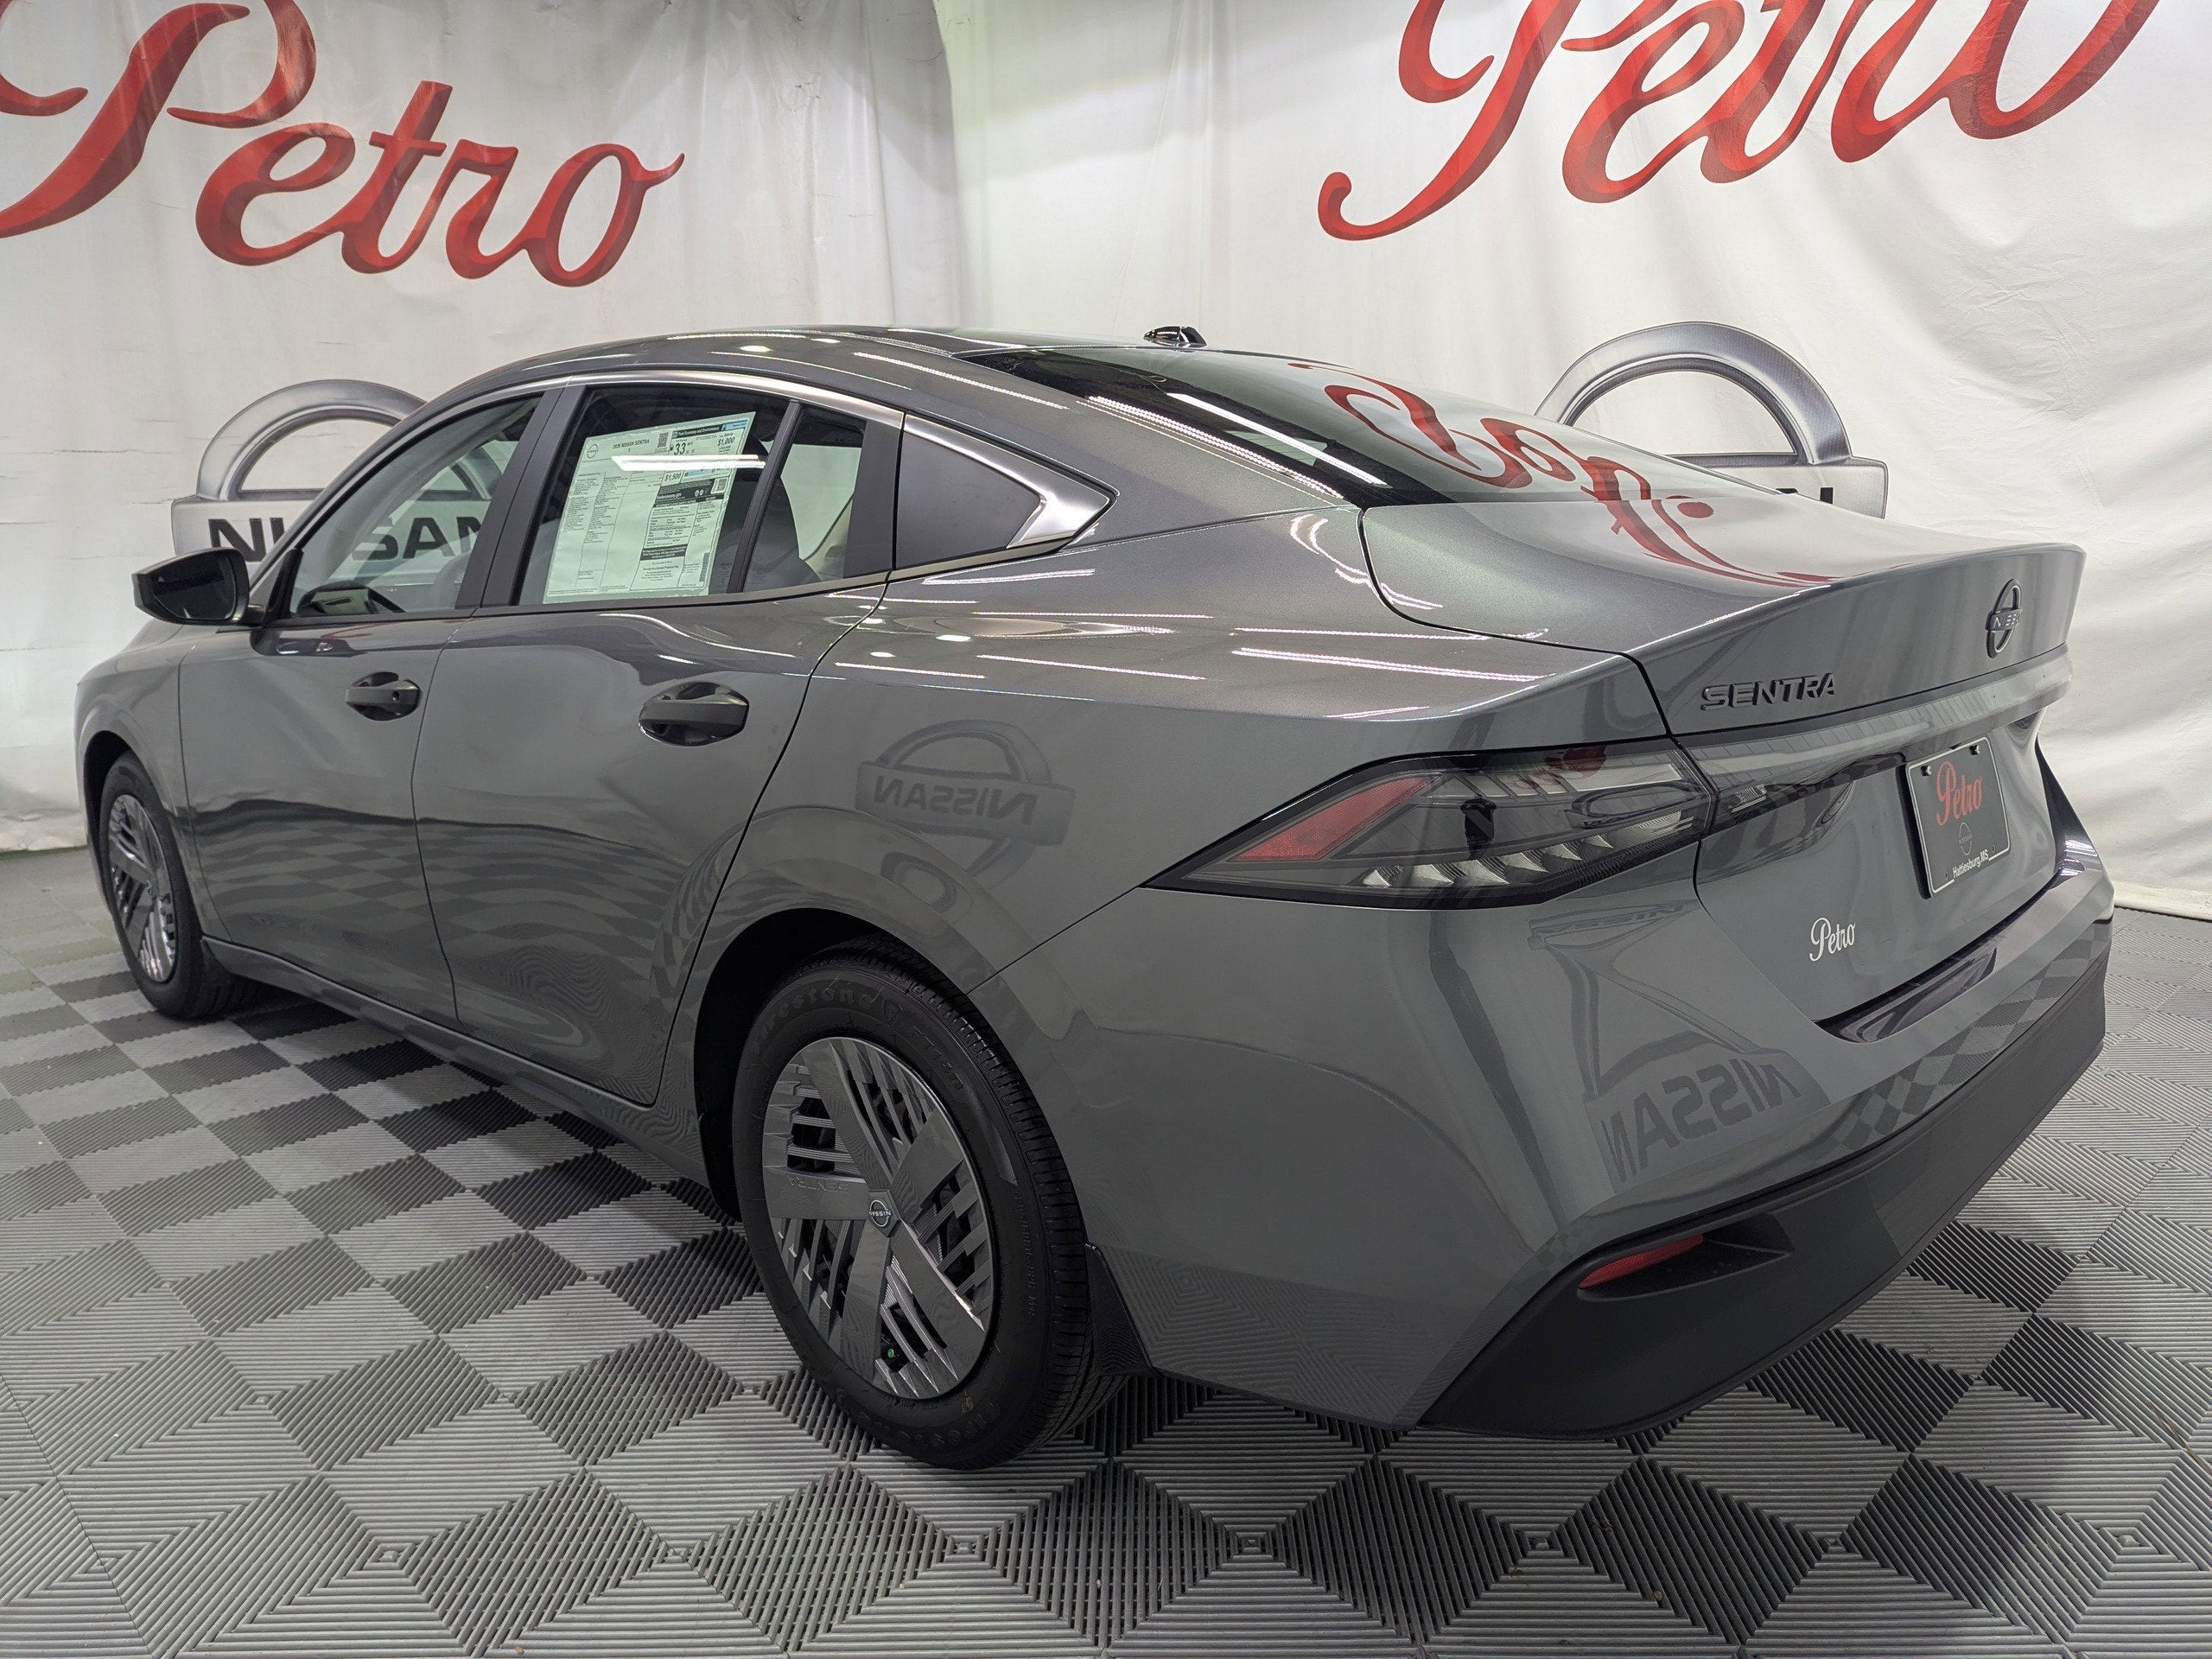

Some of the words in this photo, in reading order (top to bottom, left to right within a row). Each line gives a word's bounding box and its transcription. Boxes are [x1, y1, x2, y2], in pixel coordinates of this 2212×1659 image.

[0, 0, 685, 287] Petro
[674, 442, 686, 455] 33
[208, 517, 482, 563] NISA
[1700, 672, 1835, 711] SENTRA
[1936, 760, 1983, 826] Petro
[1808, 917, 1856, 962] Petro
